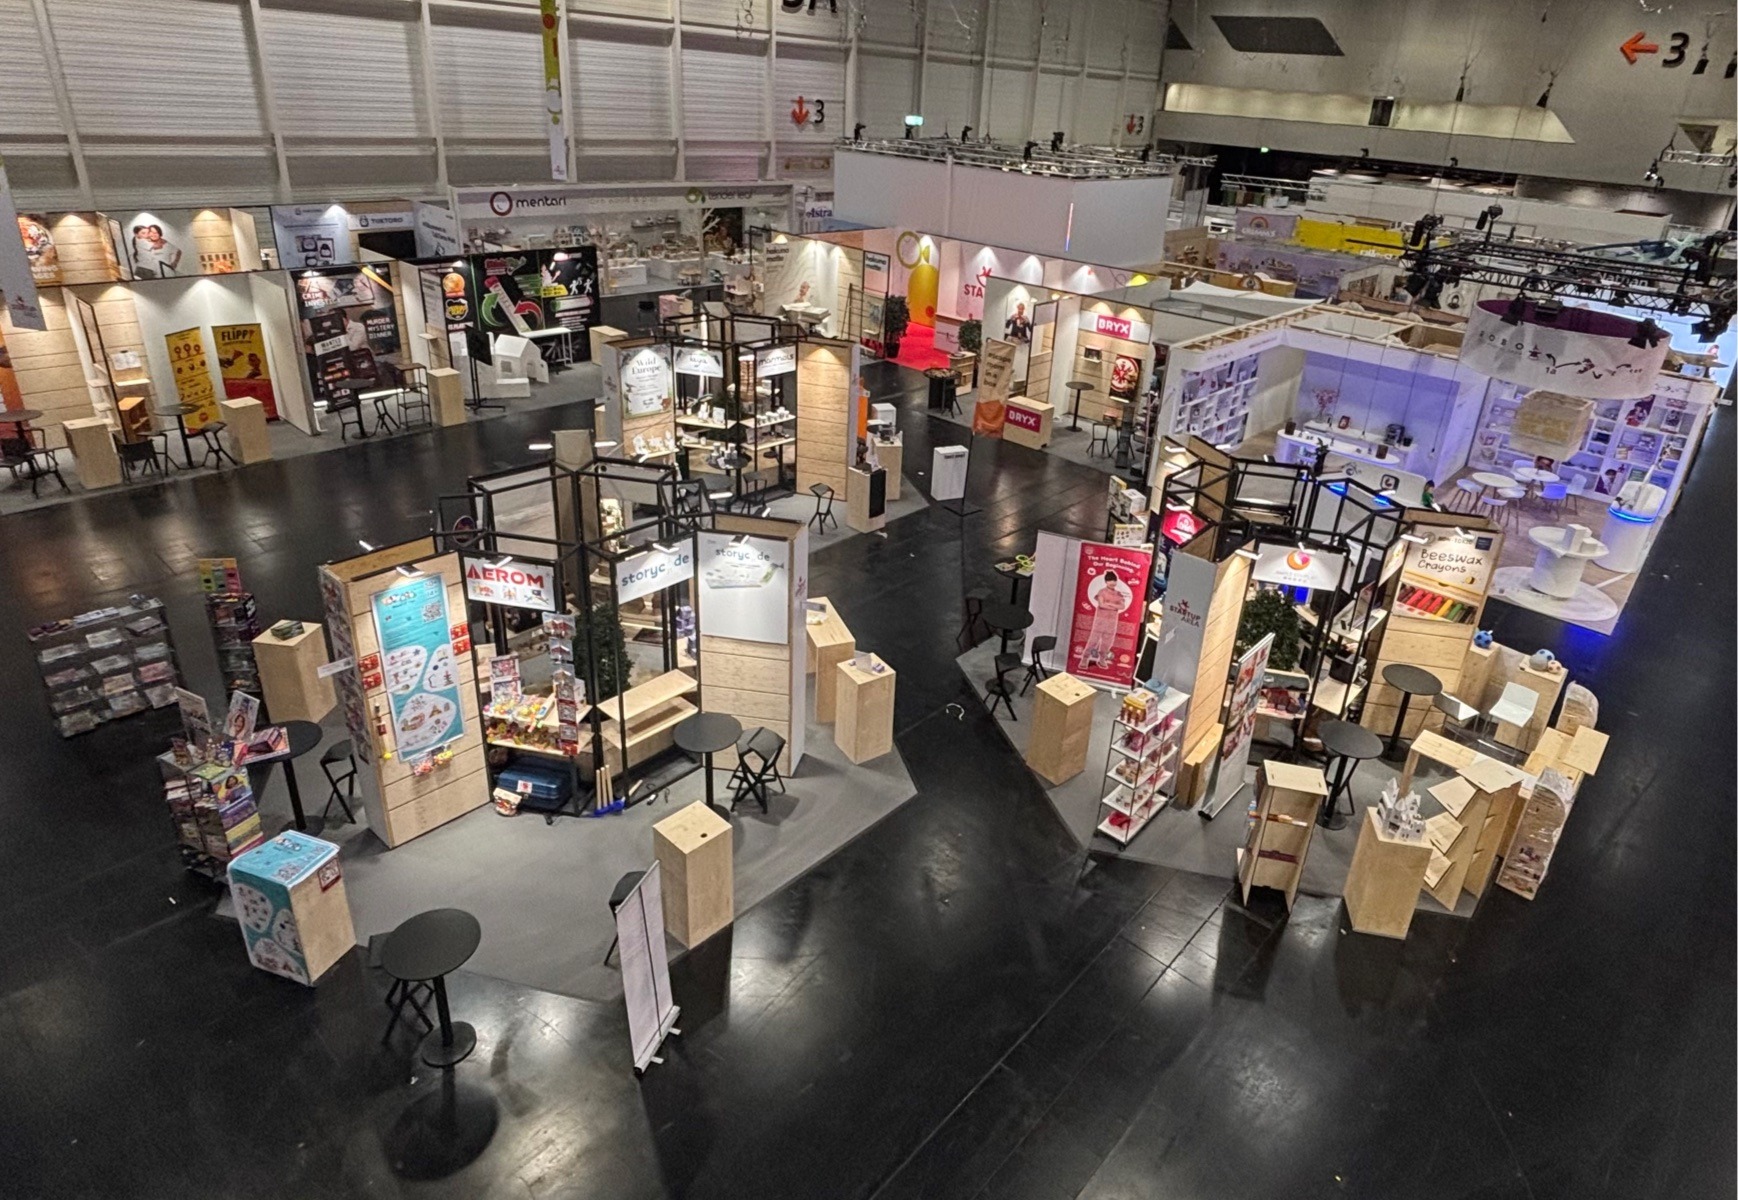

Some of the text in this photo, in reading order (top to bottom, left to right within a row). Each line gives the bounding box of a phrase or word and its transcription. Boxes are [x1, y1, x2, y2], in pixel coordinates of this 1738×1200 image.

[1662, 31, 1690, 68] 3
[814, 99, 825, 124] 3
[1136, 115, 1144, 135] 3
[515, 195, 567, 208] mentari
[806, 207, 833, 219] Astra
[1098, 318, 1130, 335] BRYX
[1008, 410, 1036, 427] BRYX
[1420, 548, 1483, 565] Beeswax
[1417, 559, 1467, 573] Crayons
[467, 563, 545, 589] AEROM
[1169, 604, 1201, 621] STARTUP
[1181, 615, 1200, 628] AREA
